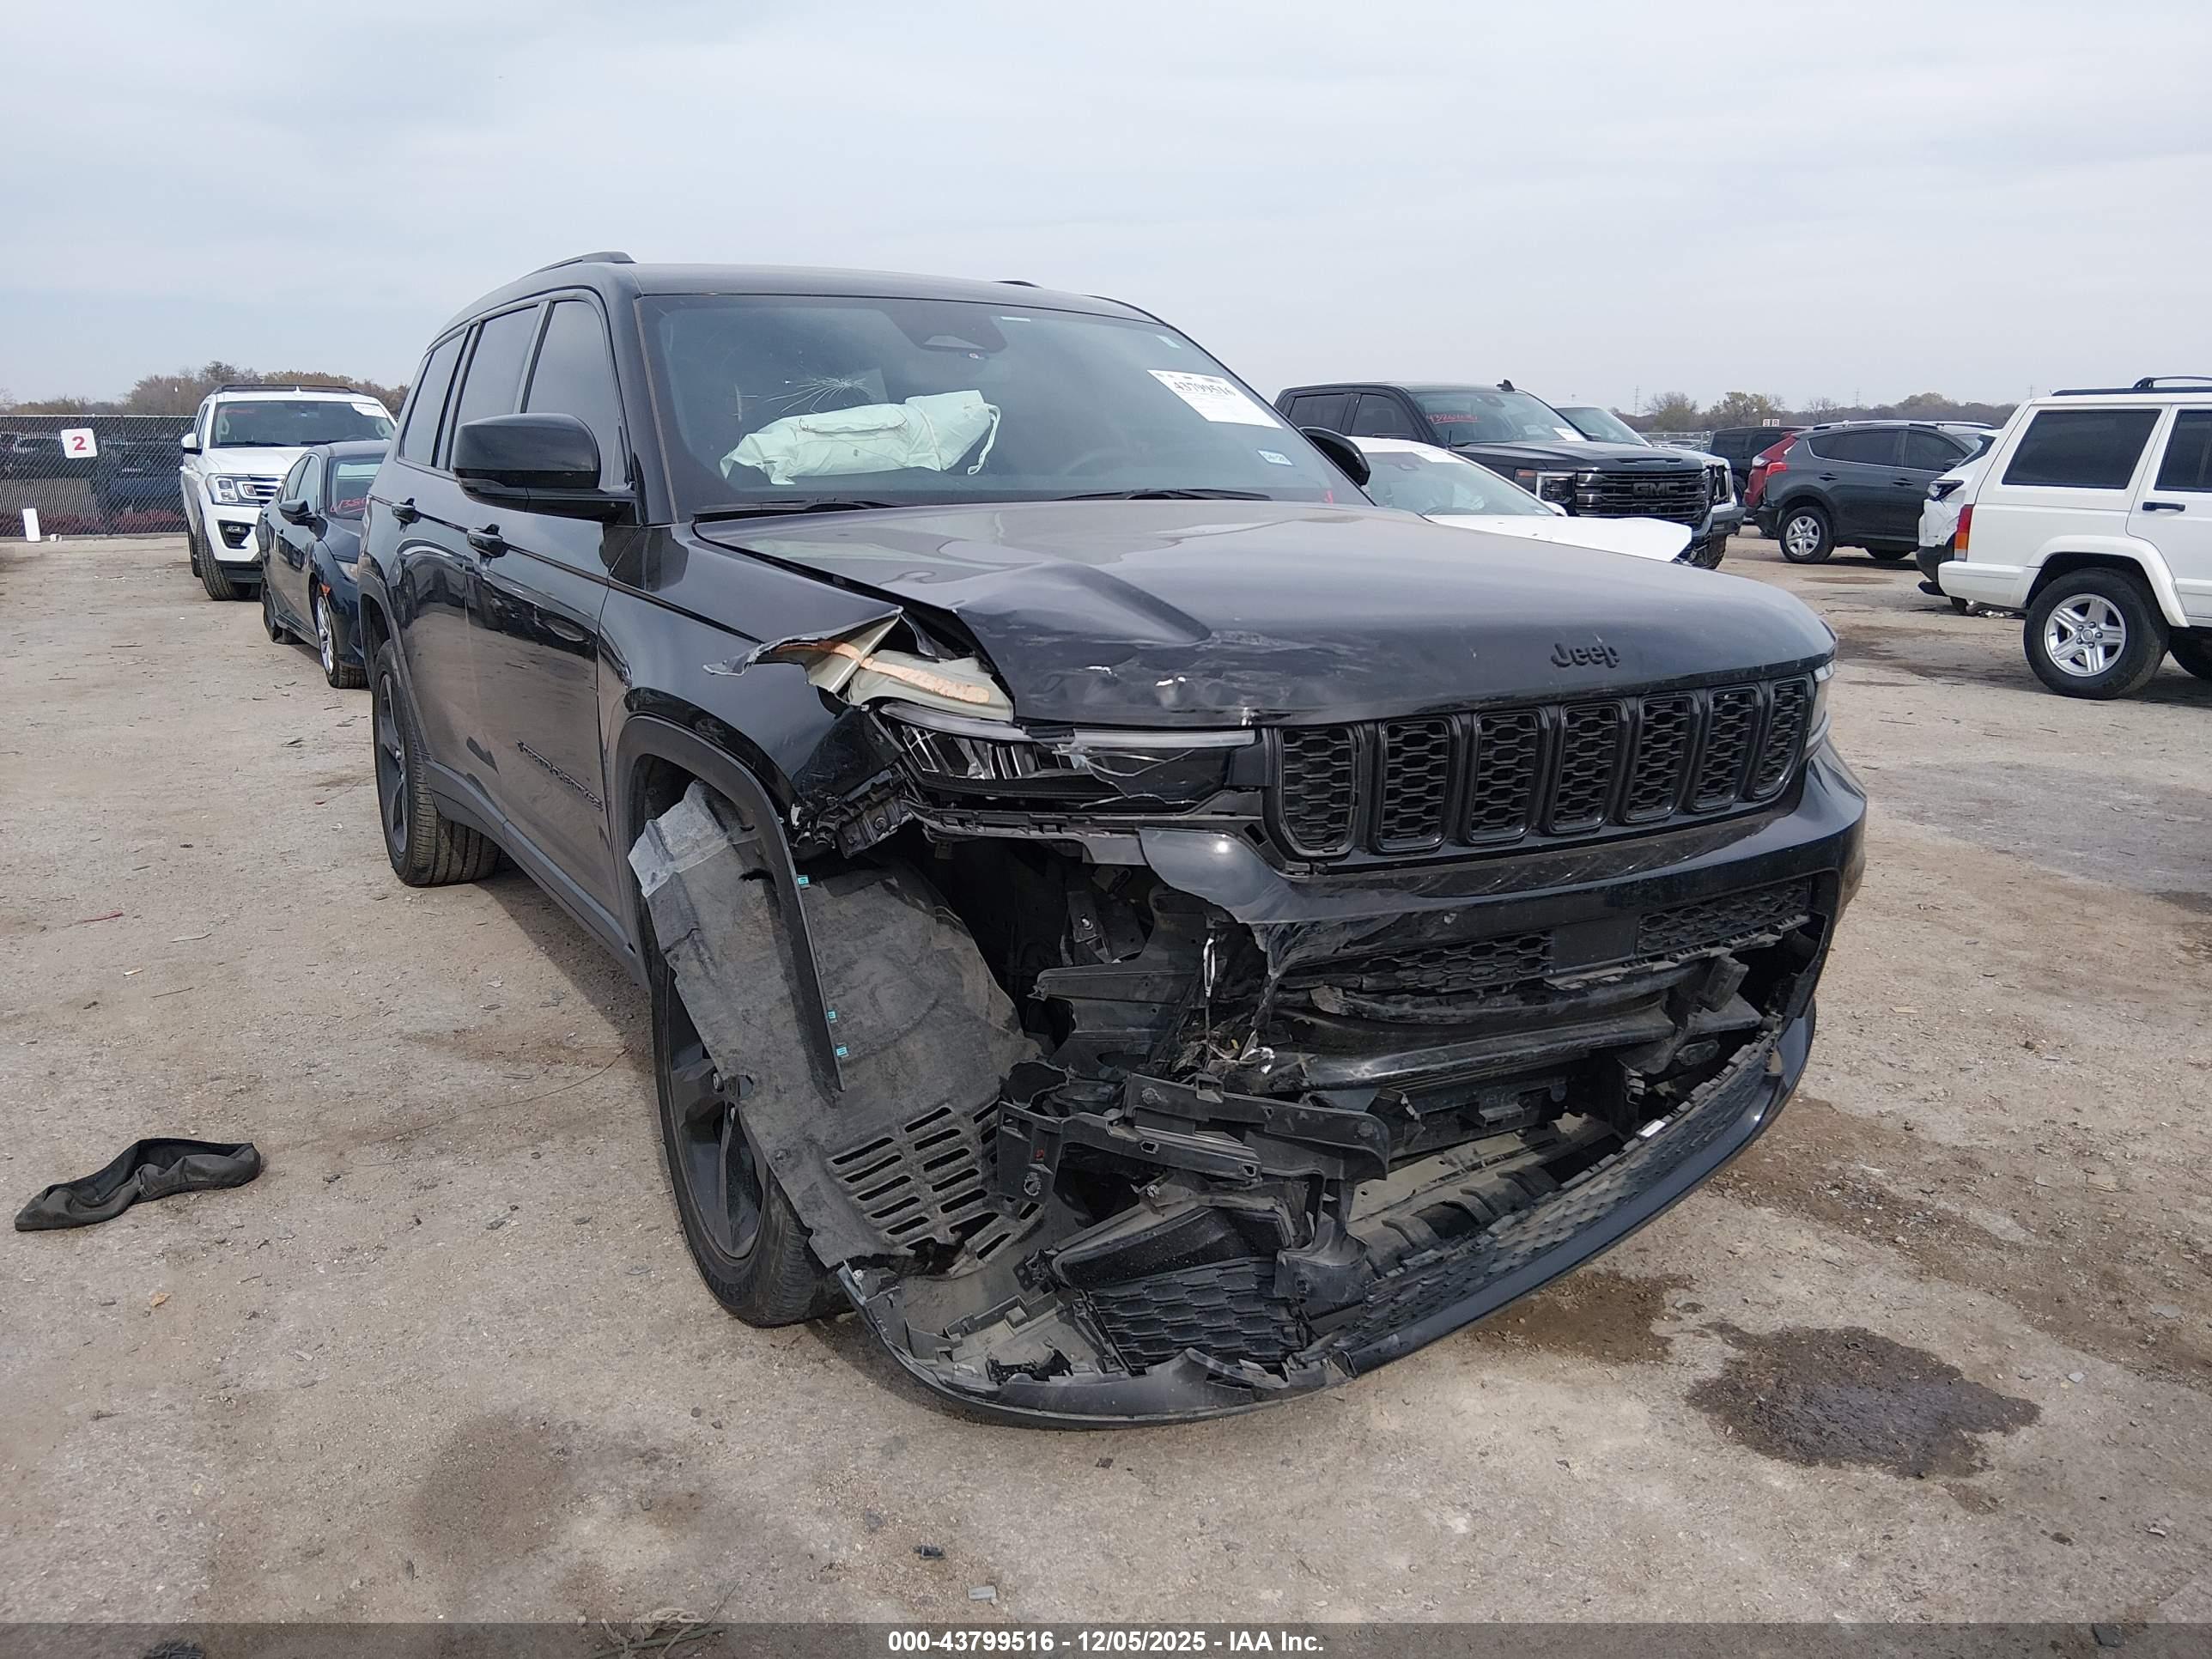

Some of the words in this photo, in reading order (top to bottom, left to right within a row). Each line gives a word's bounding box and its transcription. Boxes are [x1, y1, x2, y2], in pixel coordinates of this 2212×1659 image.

[72, 435, 87, 451] 2
[1633, 482, 1679, 496] GMC
[1551, 643, 1620, 668] Jeep
